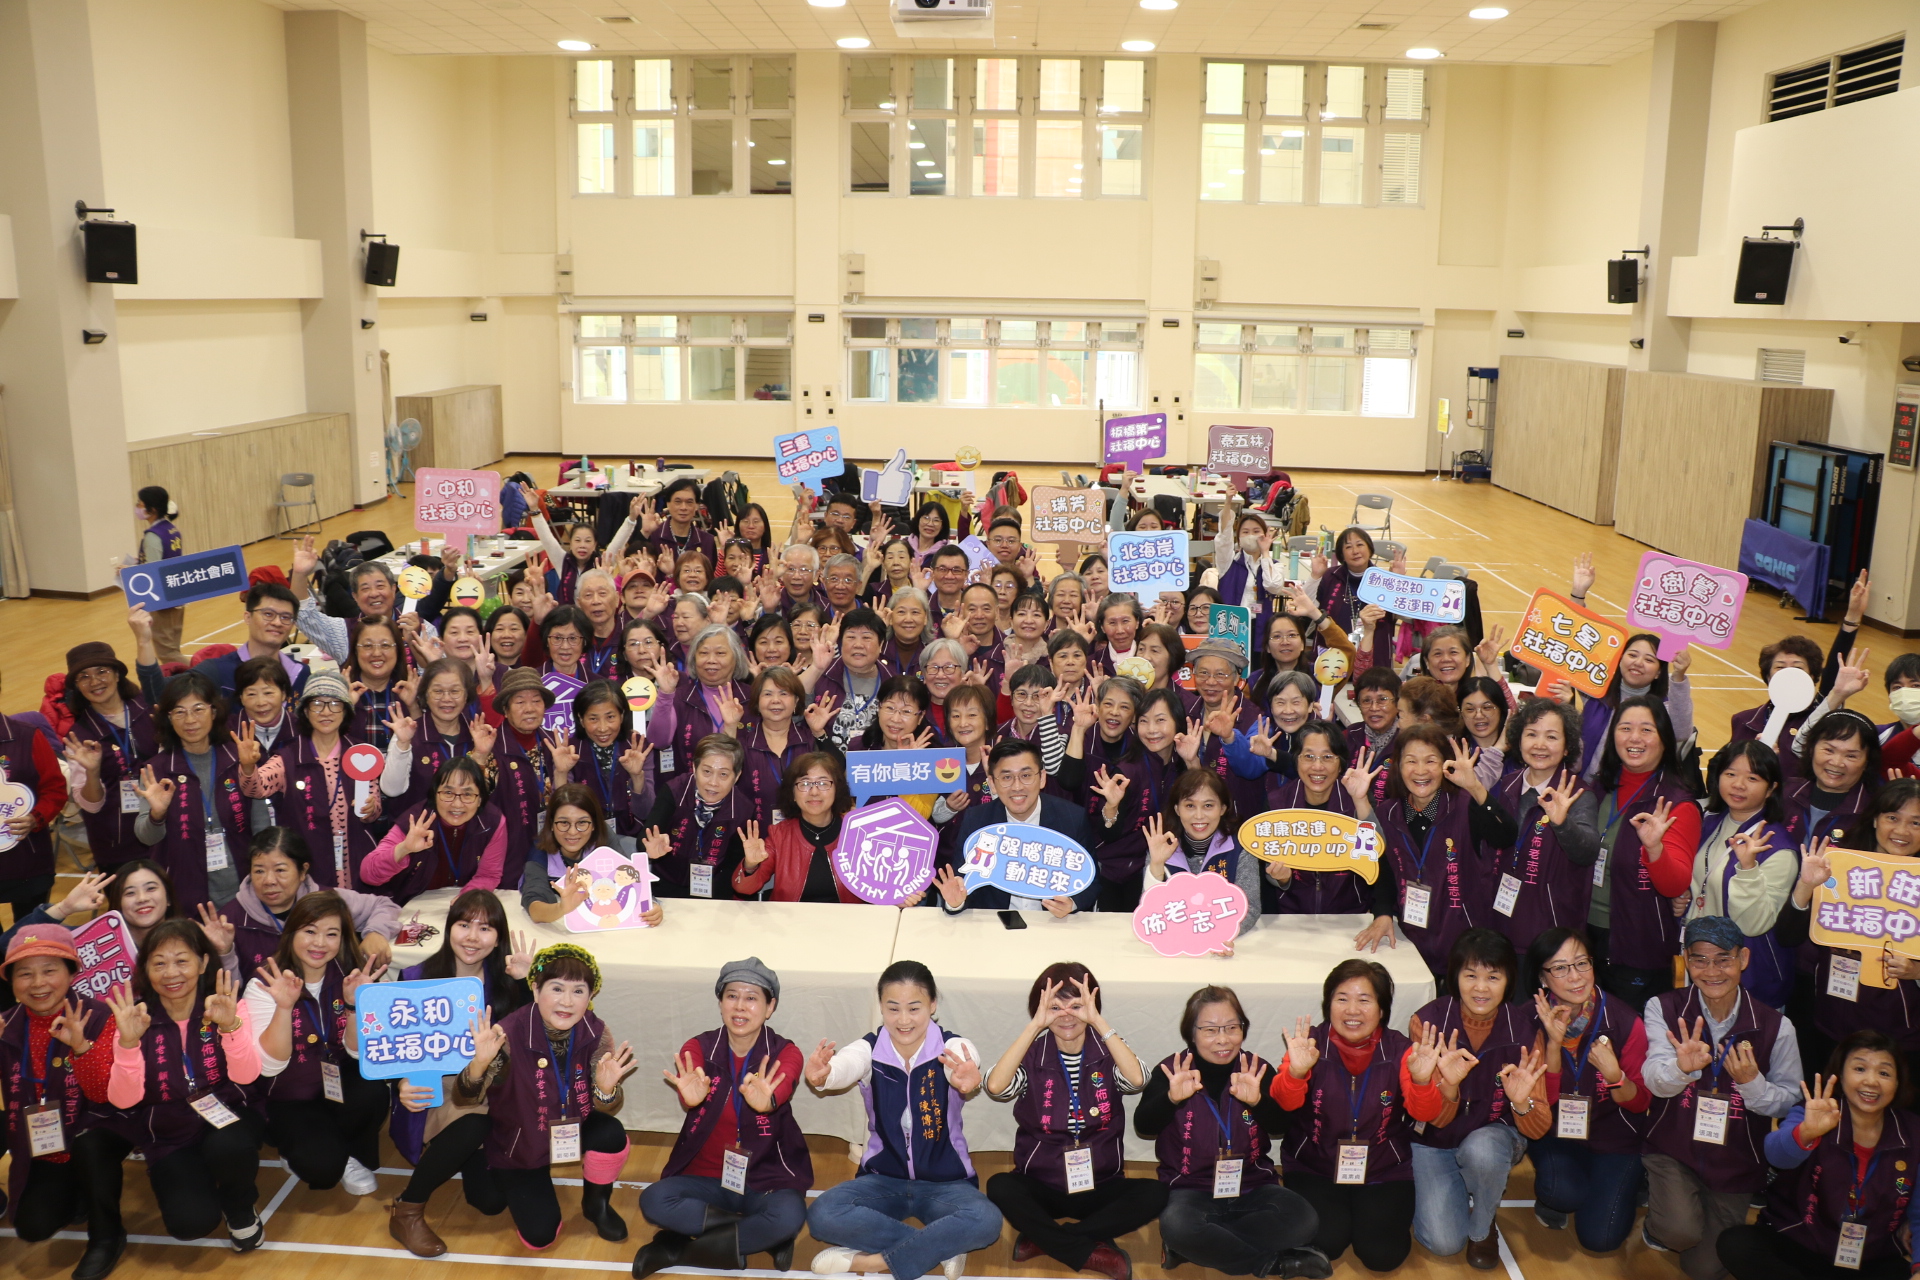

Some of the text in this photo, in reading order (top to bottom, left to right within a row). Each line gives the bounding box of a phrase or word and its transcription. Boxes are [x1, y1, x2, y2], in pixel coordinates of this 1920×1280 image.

[779, 434, 811, 457] 三重
[1110, 423, 1161, 439] 板橋第一
[1110, 436, 1161, 452] 社福中心
[1220, 434, 1264, 448] 泰五林
[779, 446, 838, 477] 社福中心
[1211, 450, 1268, 469] 社福中心
[438, 479, 475, 499] 中和
[1050, 495, 1086, 513] 瑞芳
[420, 500, 494, 521] 社福中心
[1035, 516, 1102, 534] 社福中心
[1121, 537, 1175, 562] 北海岸
[165, 562, 235, 588] 新北社會局
[1113, 558, 1185, 585] 社福中心
[1755, 552, 1796, 582] DONIC
[1368, 572, 1423, 594] 動腦認知
[1394, 597, 1435, 614] 活運用
[1634, 593, 1731, 636] 社福中心
[1551, 612, 1601, 651] 七星
[1521, 628, 1608, 685] 社福中心
[1254, 820, 1327, 837] 健康促進
[999, 835, 1085, 871] 醒腦體智
[1263, 840, 1347, 857] 活力 up up
[1524, 835, 1543, 885] 佈老志工
[838, 852, 931, 900] HEALTHY AGING
[1005, 861, 1071, 893] 動起來
[1446, 862, 1462, 908] 佈老志工
[1847, 866, 1920, 908] 新莊
[1141, 897, 1238, 936] 佈老志工
[1818, 902, 1920, 943] 社福中
[291, 1008, 303, 1038] 存老本
[389, 997, 452, 1029] 永和
[365, 1029, 477, 1065] 社福中心
[10, 1061, 21, 1094] 存老本
[155, 1034, 172, 1101] 存老本 顧未來
[64, 1074, 80, 1126] 佈老志工
[534, 1069, 549, 1132] 存老本 顧未來
[1043, 1079, 1054, 1109] 存老本
[1312, 1089, 1324, 1115] 存老本
[1094, 1088, 1112, 1132] 佈老志工
[1180, 1110, 1194, 1175] 存老本 顧未來
